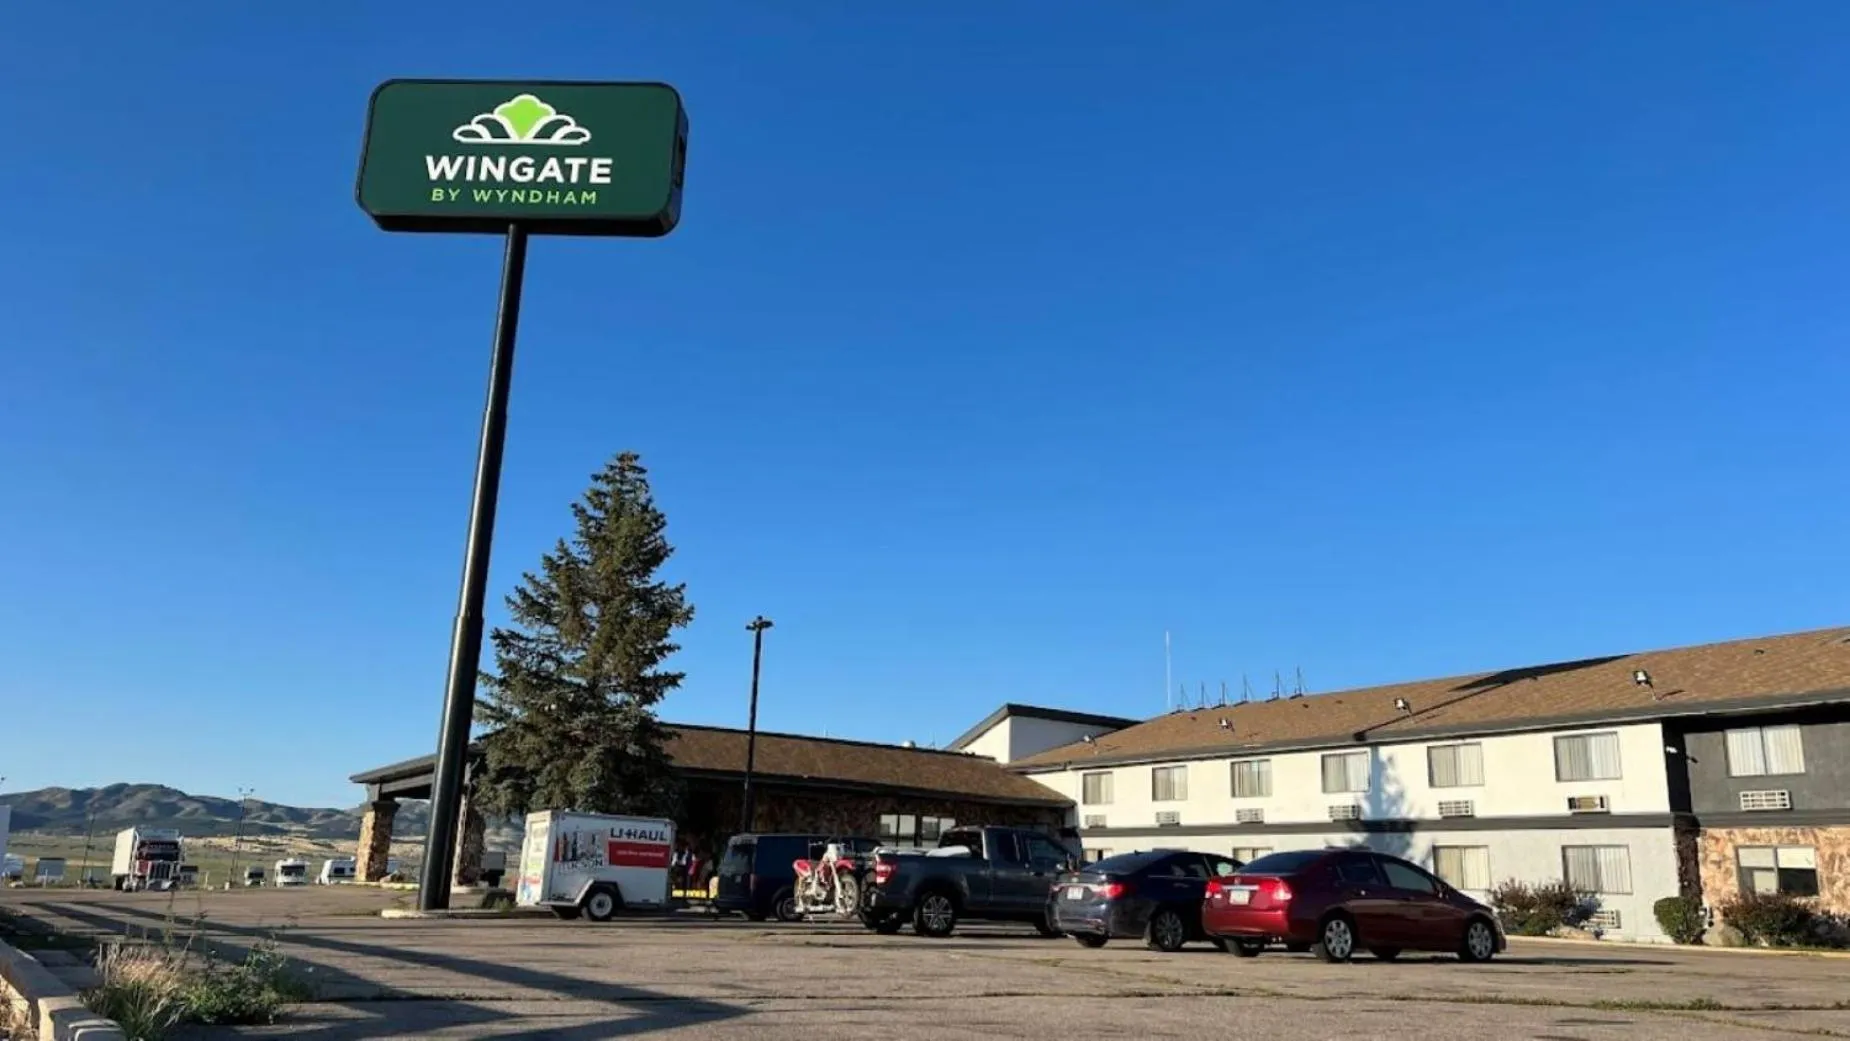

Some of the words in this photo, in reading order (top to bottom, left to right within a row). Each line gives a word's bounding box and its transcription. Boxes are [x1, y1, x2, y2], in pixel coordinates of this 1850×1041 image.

[425, 155, 613, 184] WINGATE
[431, 188, 461, 202] BY
[473, 189, 597, 204] WYNDHAM
